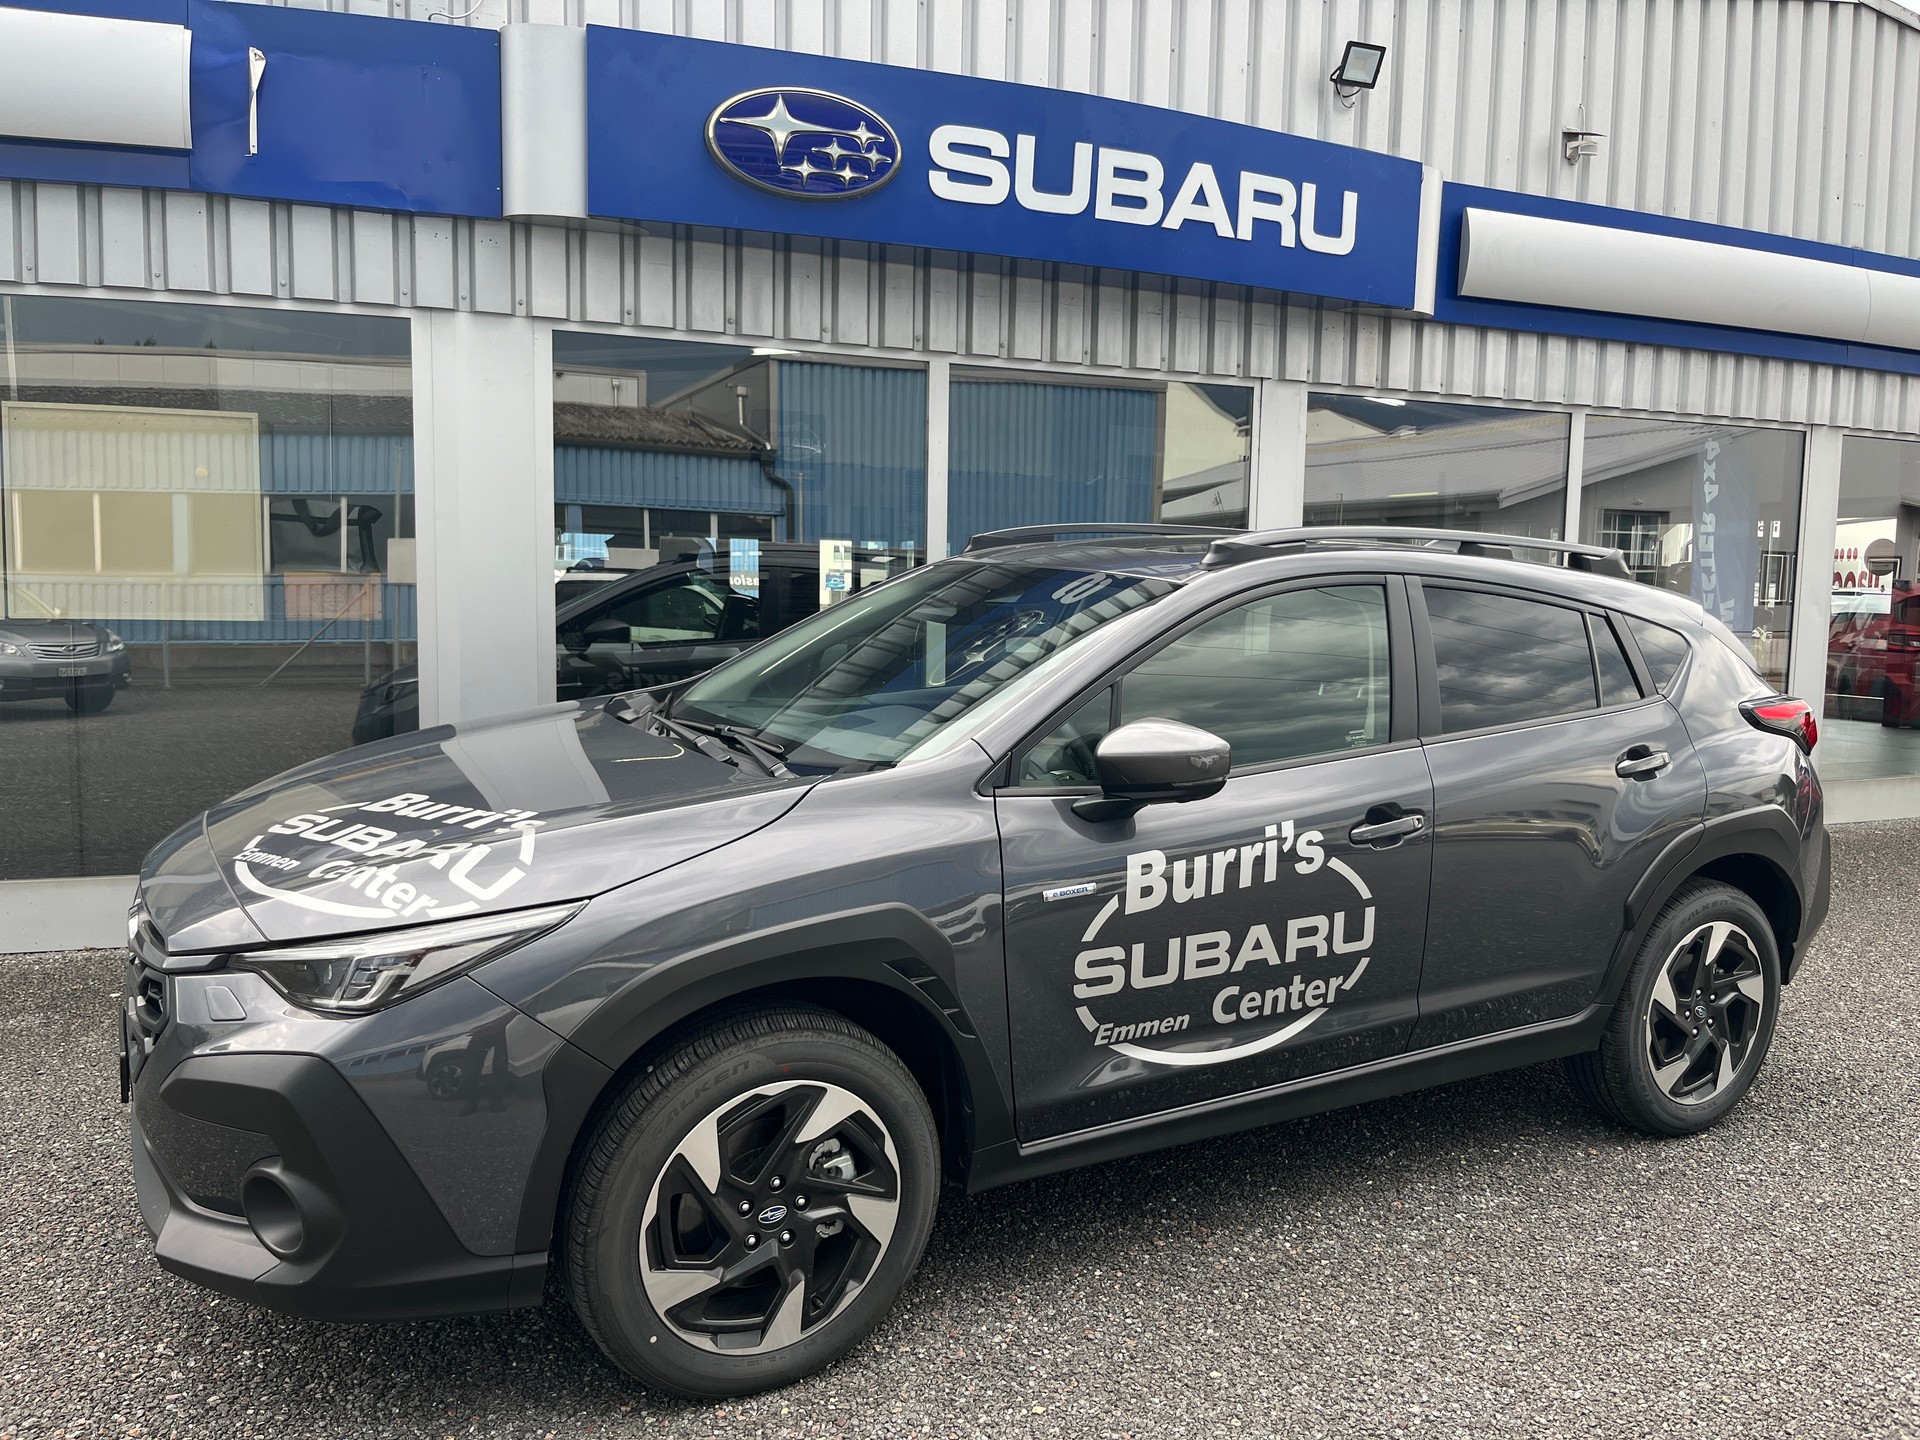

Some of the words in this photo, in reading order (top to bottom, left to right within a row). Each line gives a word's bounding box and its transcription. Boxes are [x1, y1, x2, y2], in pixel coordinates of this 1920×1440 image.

[927, 124, 1358, 256] SUBARU
[267, 813, 526, 900] SUBARU
[358, 792, 547, 834] Burri's
[232, 847, 301, 870] Emmen
[307, 860, 439, 917] Center
[1124, 819, 1325, 915] Burri's
[1073, 906, 1376, 999] SUBARU
[1094, 1013, 1190, 1047] Emmen
[1212, 975, 1343, 1024] Center
